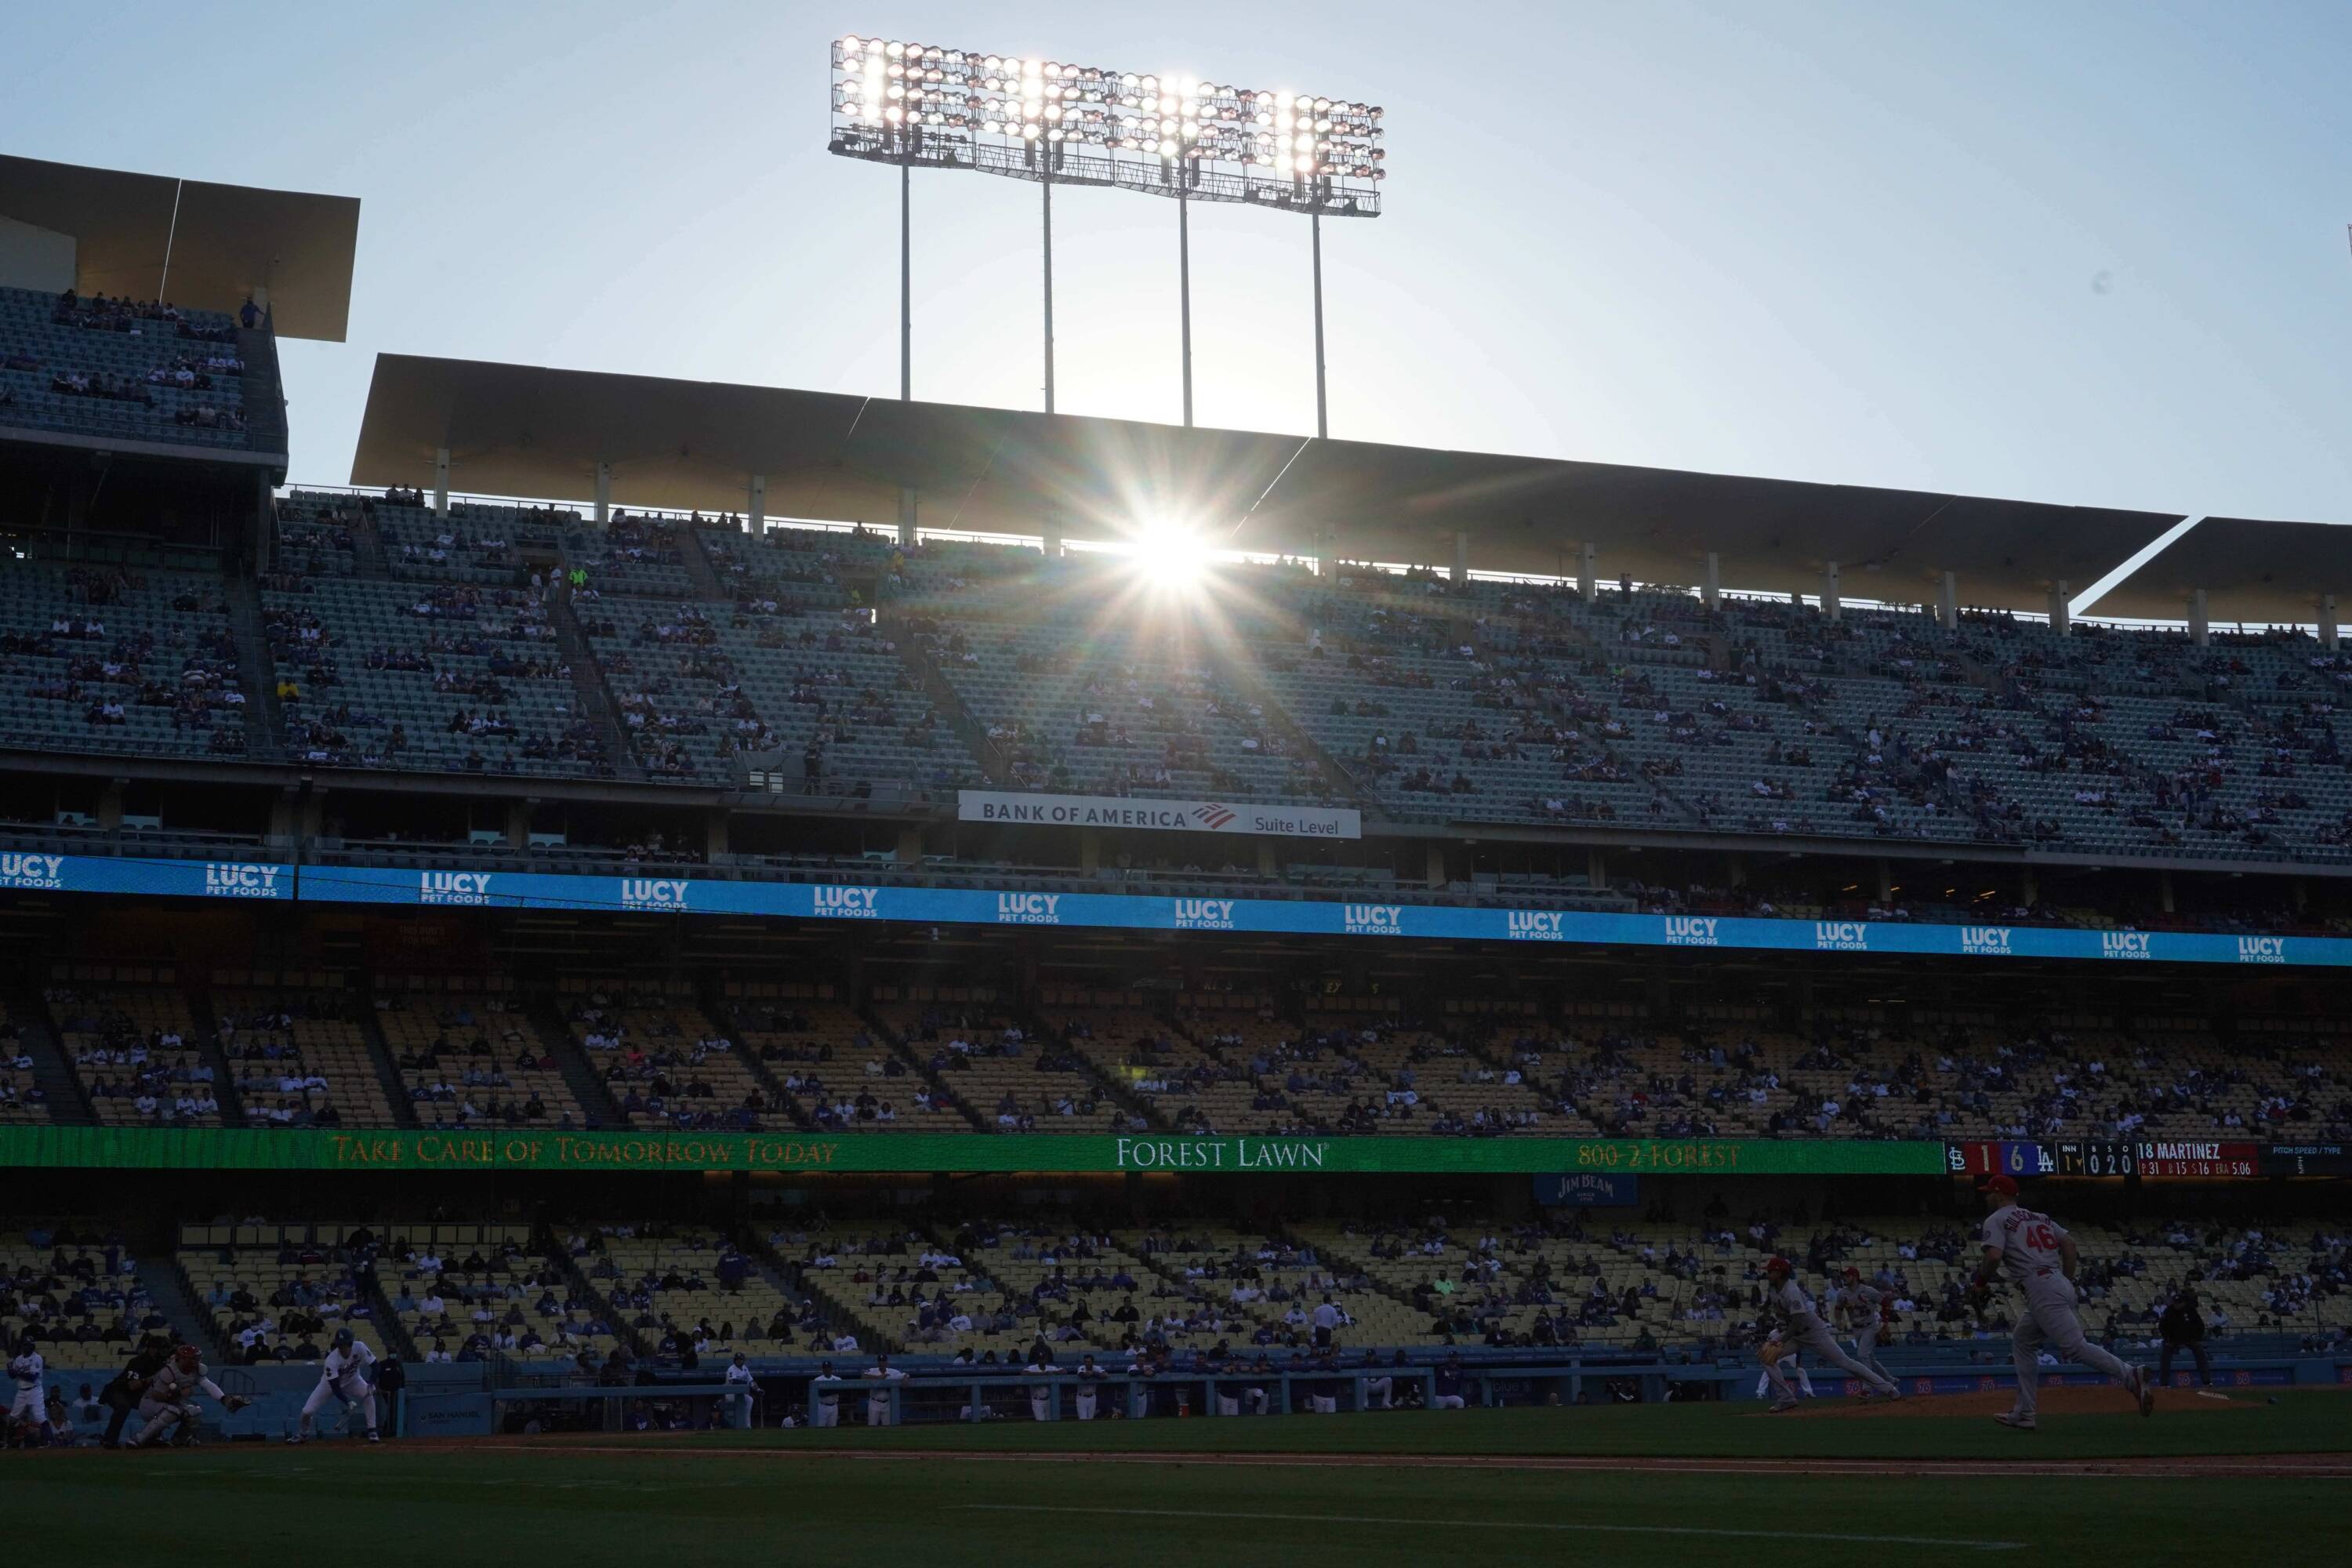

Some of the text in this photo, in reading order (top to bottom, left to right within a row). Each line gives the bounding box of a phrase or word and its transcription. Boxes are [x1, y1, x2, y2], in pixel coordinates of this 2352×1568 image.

[983, 803, 1338, 835] BANK OF AMERICA Suite Level
[0, 855, 63, 878] UCY
[207, 865, 278, 887] LUCY
[15, 877, 62, 888] FOODS
[233, 887, 276, 896] FOODS
[422, 873, 490, 894] LUCY
[622, 880, 688, 902] LUCY
[622, 901, 641, 909] PET
[815, 887, 877, 908] LUCY
[999, 894, 1058, 914] LUCY
[838, 908, 876, 916] FOODS
[1176, 899, 1233, 920] LUCY
[1345, 906, 1401, 925] LUCY
[1509, 912, 1562, 931] LUCY
[1666, 918, 1716, 936] LUCY
[1817, 923, 1865, 941] LUCY
[1962, 928, 2009, 946] LUCY
[2103, 933, 2149, 950] LUCY
[2239, 938, 2283, 954] LUCY
[332, 1134, 840, 1165] TAKE CARE OF TOMORROW TODAY
[1116, 1138, 1227, 1167] FOREST
[1578, 1144, 1742, 1167] 800-2-FOREST
[1981, 1145, 1990, 1171] 1
[2010, 1145, 2024, 1171] 6
[2036, 1145, 2054, 1172] LA
[2138, 1143, 2221, 1160] 18 MARTINEZ
[2064, 1155, 2071, 1171] 1
[2090, 1155, 2131, 1174] 0 2 0
[2149, 1161, 2159, 1174] 31
[2176, 1162, 2187, 1175] 15
[2198, 1162, 2209, 1175] 16
[2216, 1164, 2229, 1174] ERA
[2232, 1163, 2251, 1175] 5.06
[1558, 1174, 1614, 1199] JIM BEAM
[2026, 1224, 2058, 1253] 46
[126, 1370, 140, 1380] 73
[1918, 1380, 1932, 1392] 76
